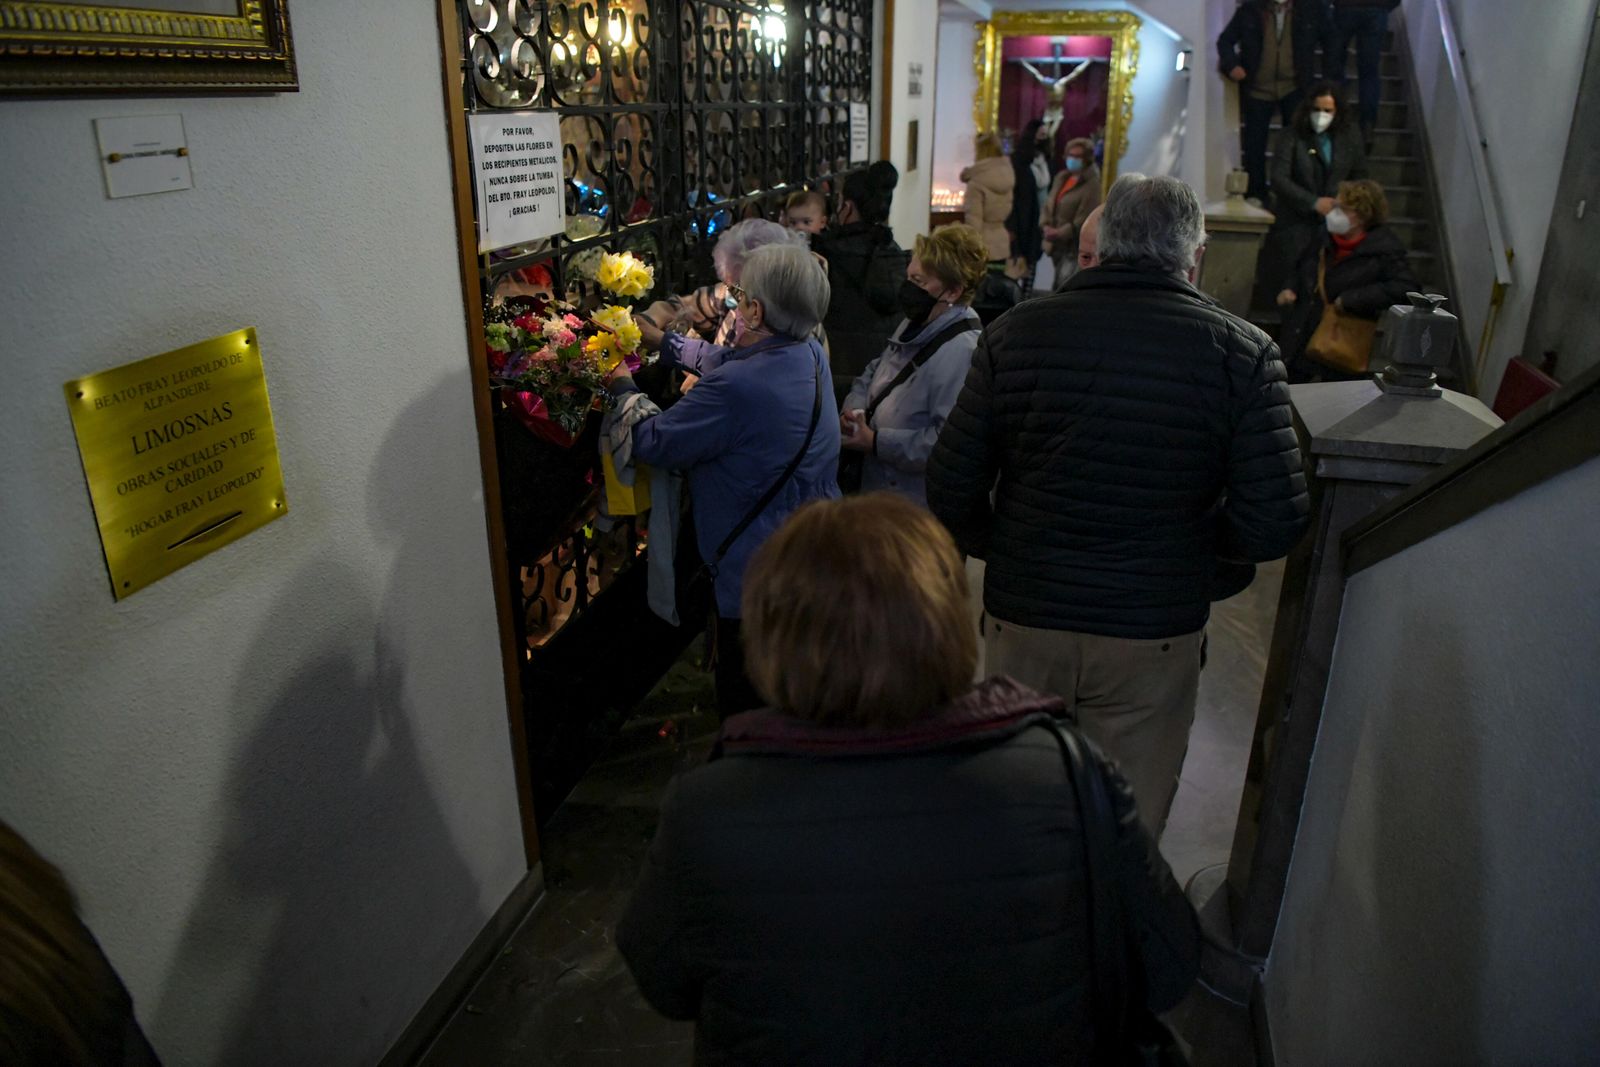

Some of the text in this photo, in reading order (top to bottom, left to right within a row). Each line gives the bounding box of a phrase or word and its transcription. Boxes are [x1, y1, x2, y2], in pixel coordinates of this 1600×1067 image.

[484, 144, 513, 153] DEPOSITEN
[515, 143, 525, 151] LAS
[526, 142, 545, 150] FLORES
[482, 161, 493, 170] LOS
[494, 159, 527, 169] RECIPIENTES
[490, 177, 508, 186] NUNCA
[510, 174, 527, 183] SOBRE
[537, 171, 553, 179] TUMBA
[488, 194, 499, 203] DEL
[513, 190, 527, 199] FRAY
[94, 352, 243, 410] BEATO FRAY LEOPOLDO DE
[143, 379, 211, 412] ALPANDEIRE
[131, 402, 233, 455] LIMOSNAS
[117, 428, 256, 496] OBRAS SOCIALES Y DE
[164, 460, 224, 494] CARIDAD
[125, 467, 264, 538] "HOGAR FRAY LEOPOLDO"
